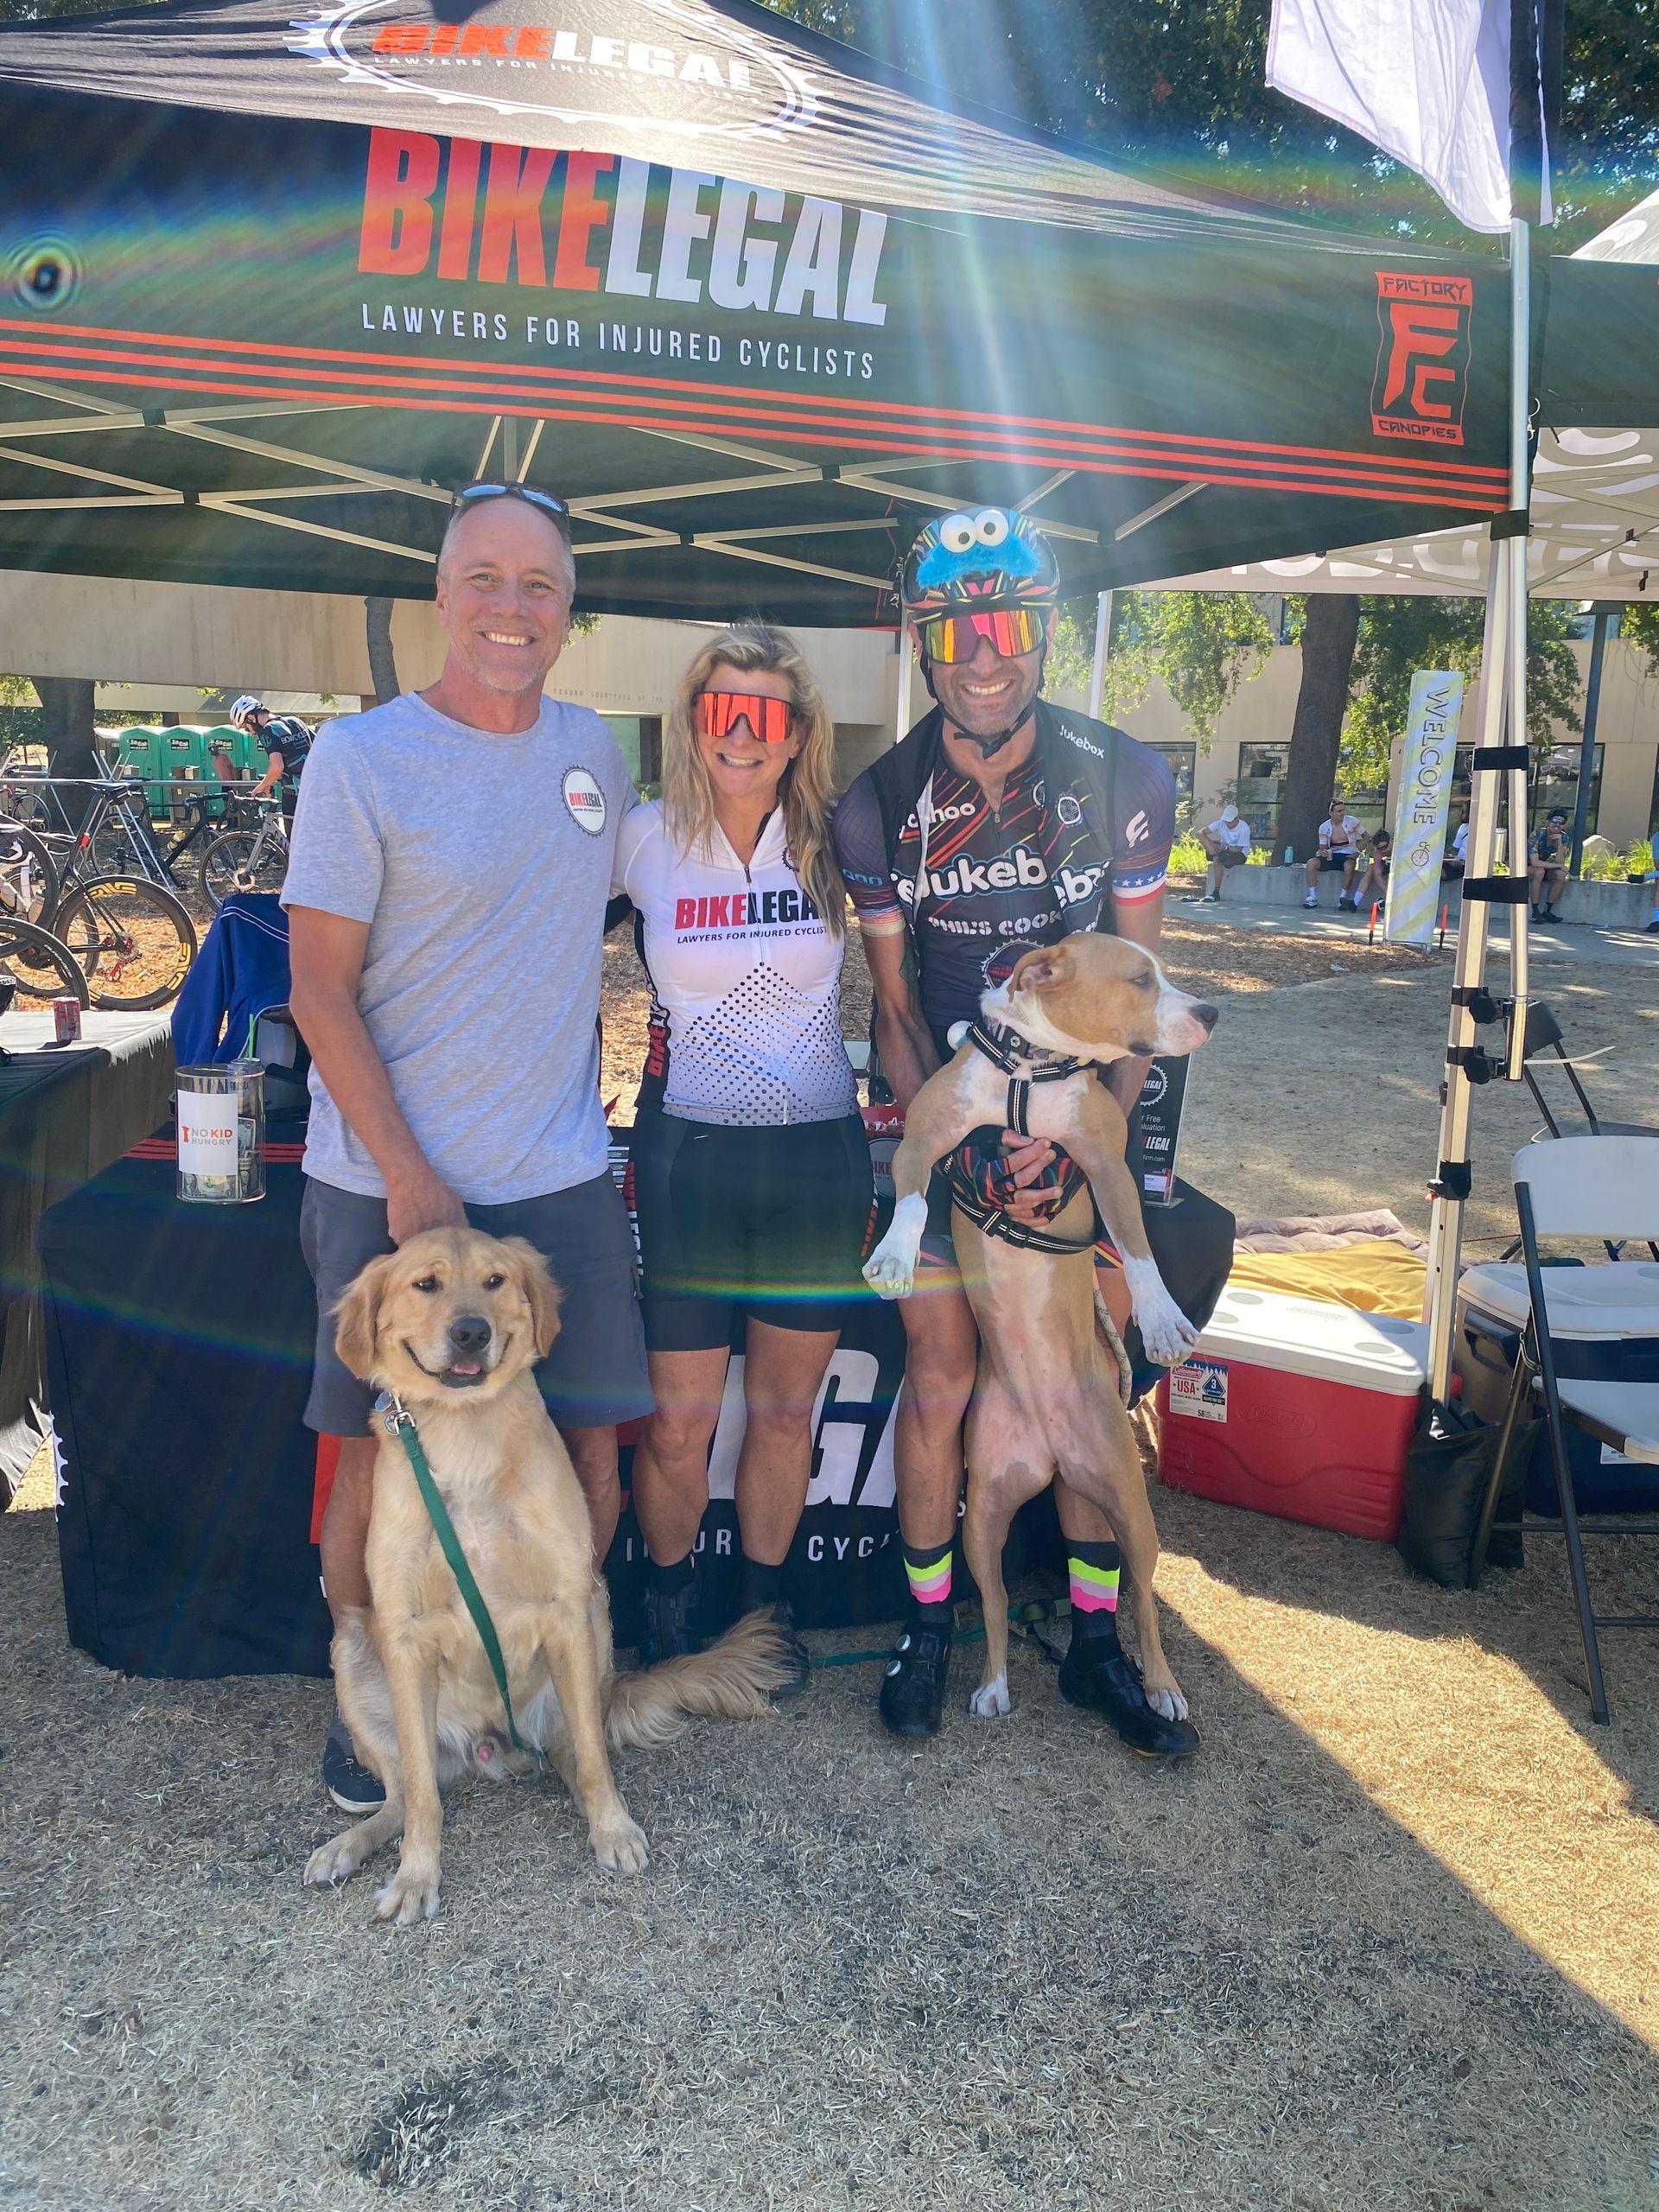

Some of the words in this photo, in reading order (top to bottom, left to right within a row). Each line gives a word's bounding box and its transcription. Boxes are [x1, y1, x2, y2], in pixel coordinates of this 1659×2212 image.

[374, 56, 481, 67] LAWYERS
[496, 60, 537, 69] FOR
[1383, 277, 1468, 302] FACTORY
[361, 302, 508, 341] LAWYERS
[526, 316, 581, 348] FOR
[599, 322, 721, 364] INJURED
[739, 340, 874, 379] CYCLISTS
[1377, 419, 1458, 440] CANOPIES
[1058, 725, 1104, 759] Jukebox
[1413, 686, 1452, 825] WELCOME
[675, 889, 822, 930] BIKELEGA
[677, 933, 722, 944] LAWYERS
[727, 931, 747, 940] FOR
[750, 929, 791, 938] INJURED
[794, 926, 827, 936] CYCLIST
[1143, 1080, 1162, 1090] LEGAL
[1146, 1115, 1161, 1123] Free
[191, 1128, 208, 1138] NO
[211, 1128, 232, 1138] KID
[1141, 1122, 1166, 1132] luation
[191, 1138, 232, 1147] HUNGRY
[1142, 1135, 1171, 1150] LEGAL
[1177, 1379, 1196, 1395] USA
[1211, 1378, 1217, 1389] 3
